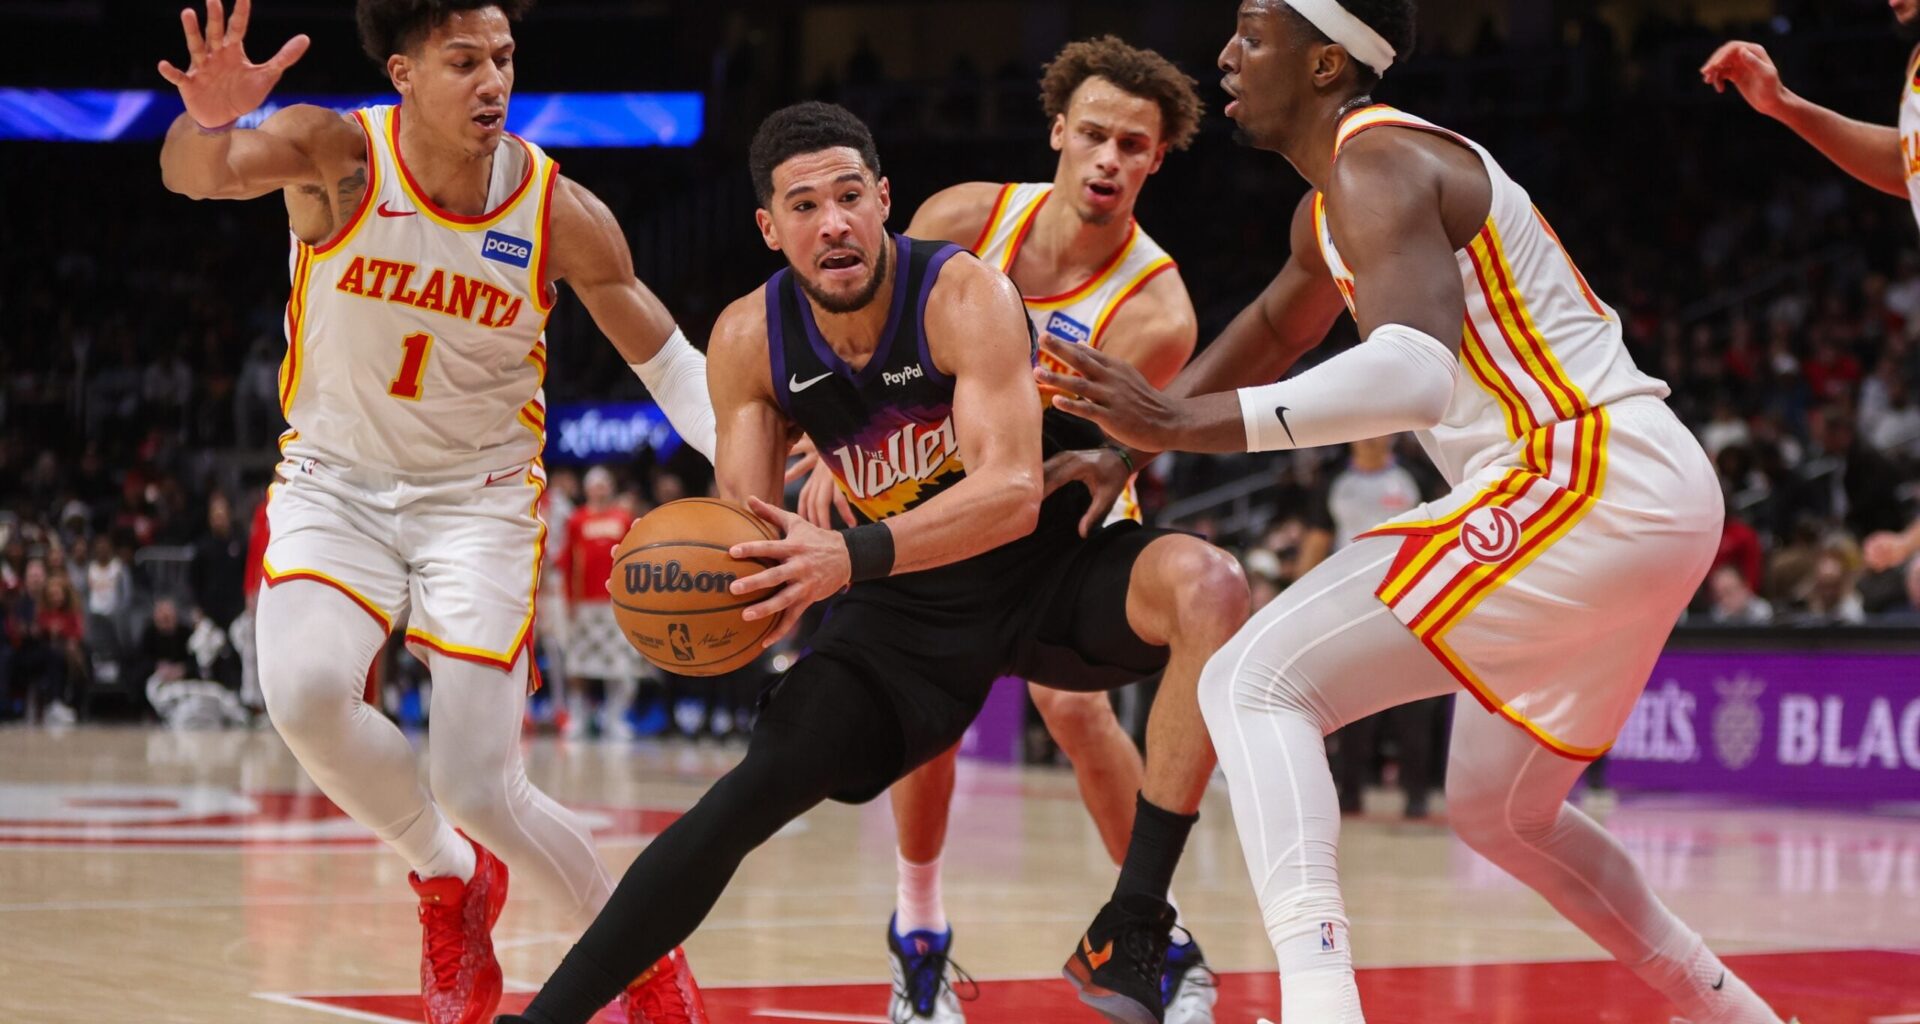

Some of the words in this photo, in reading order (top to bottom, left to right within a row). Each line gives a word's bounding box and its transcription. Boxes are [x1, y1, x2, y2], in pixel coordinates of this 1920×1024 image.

[485, 238, 528, 259] paze
[336, 256, 524, 328] ATLANTA
[388, 331, 434, 401] 1
[882, 363, 923, 386] PayPal
[865, 450, 884, 460] THE
[625, 560, 737, 595] Wilson
